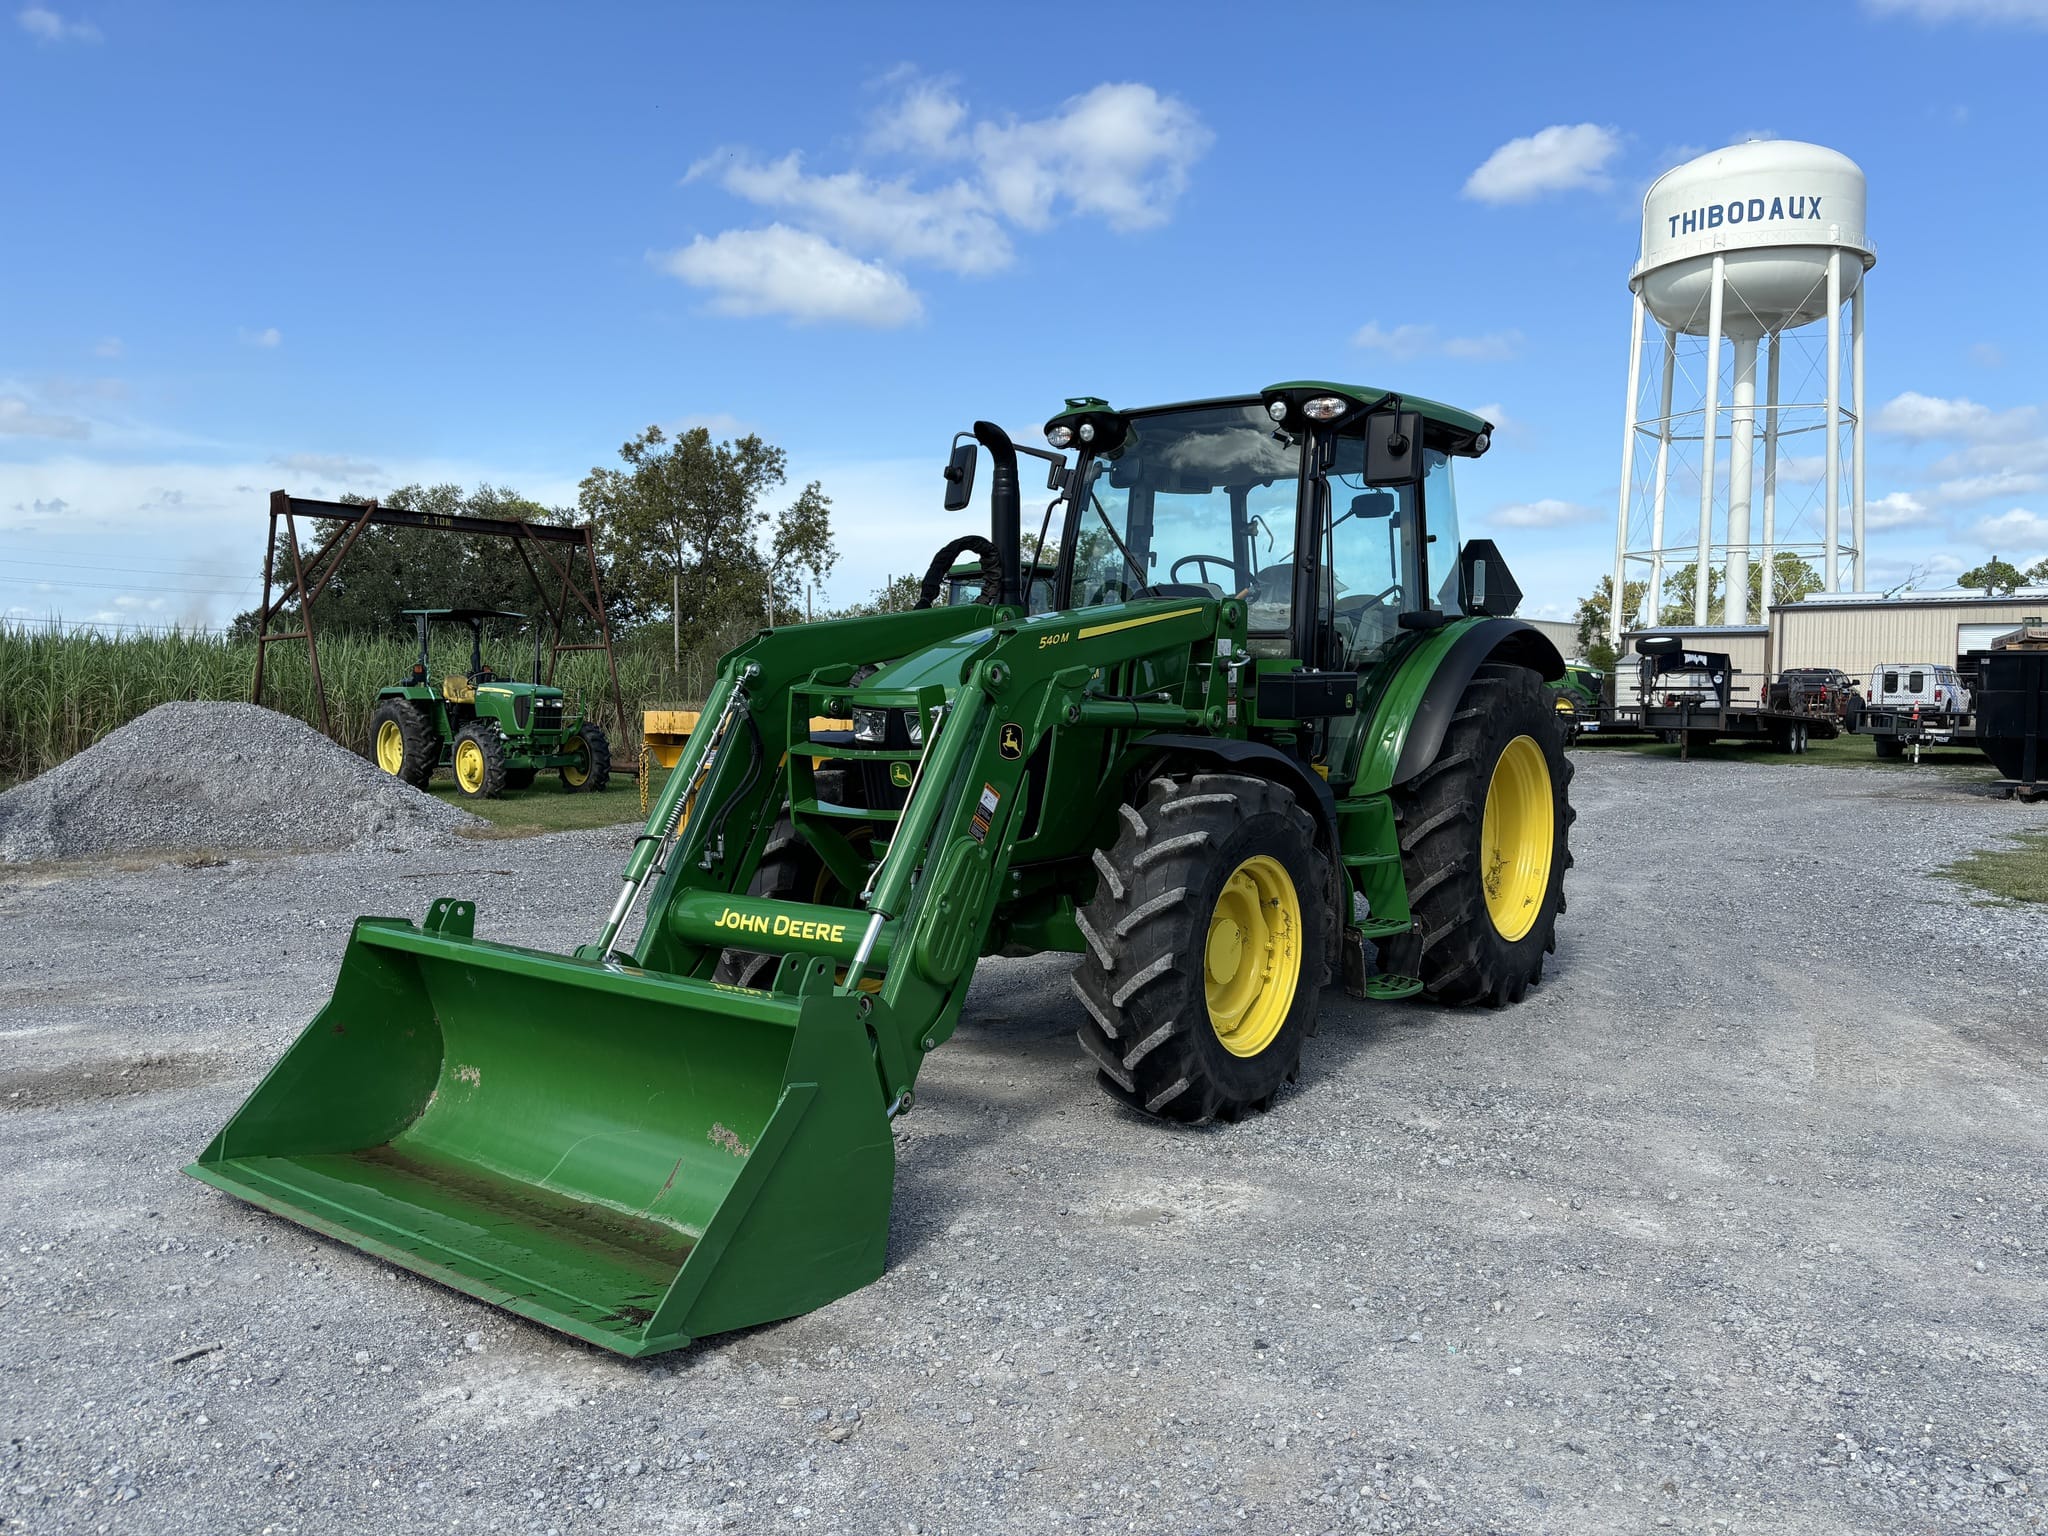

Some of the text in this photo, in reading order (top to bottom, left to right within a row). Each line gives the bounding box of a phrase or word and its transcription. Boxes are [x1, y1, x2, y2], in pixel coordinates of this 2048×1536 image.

[1668, 196, 1822, 238] THIBODAUX
[423, 515, 452, 527] 2 TON
[714, 907, 846, 943] JOHN DEERE
